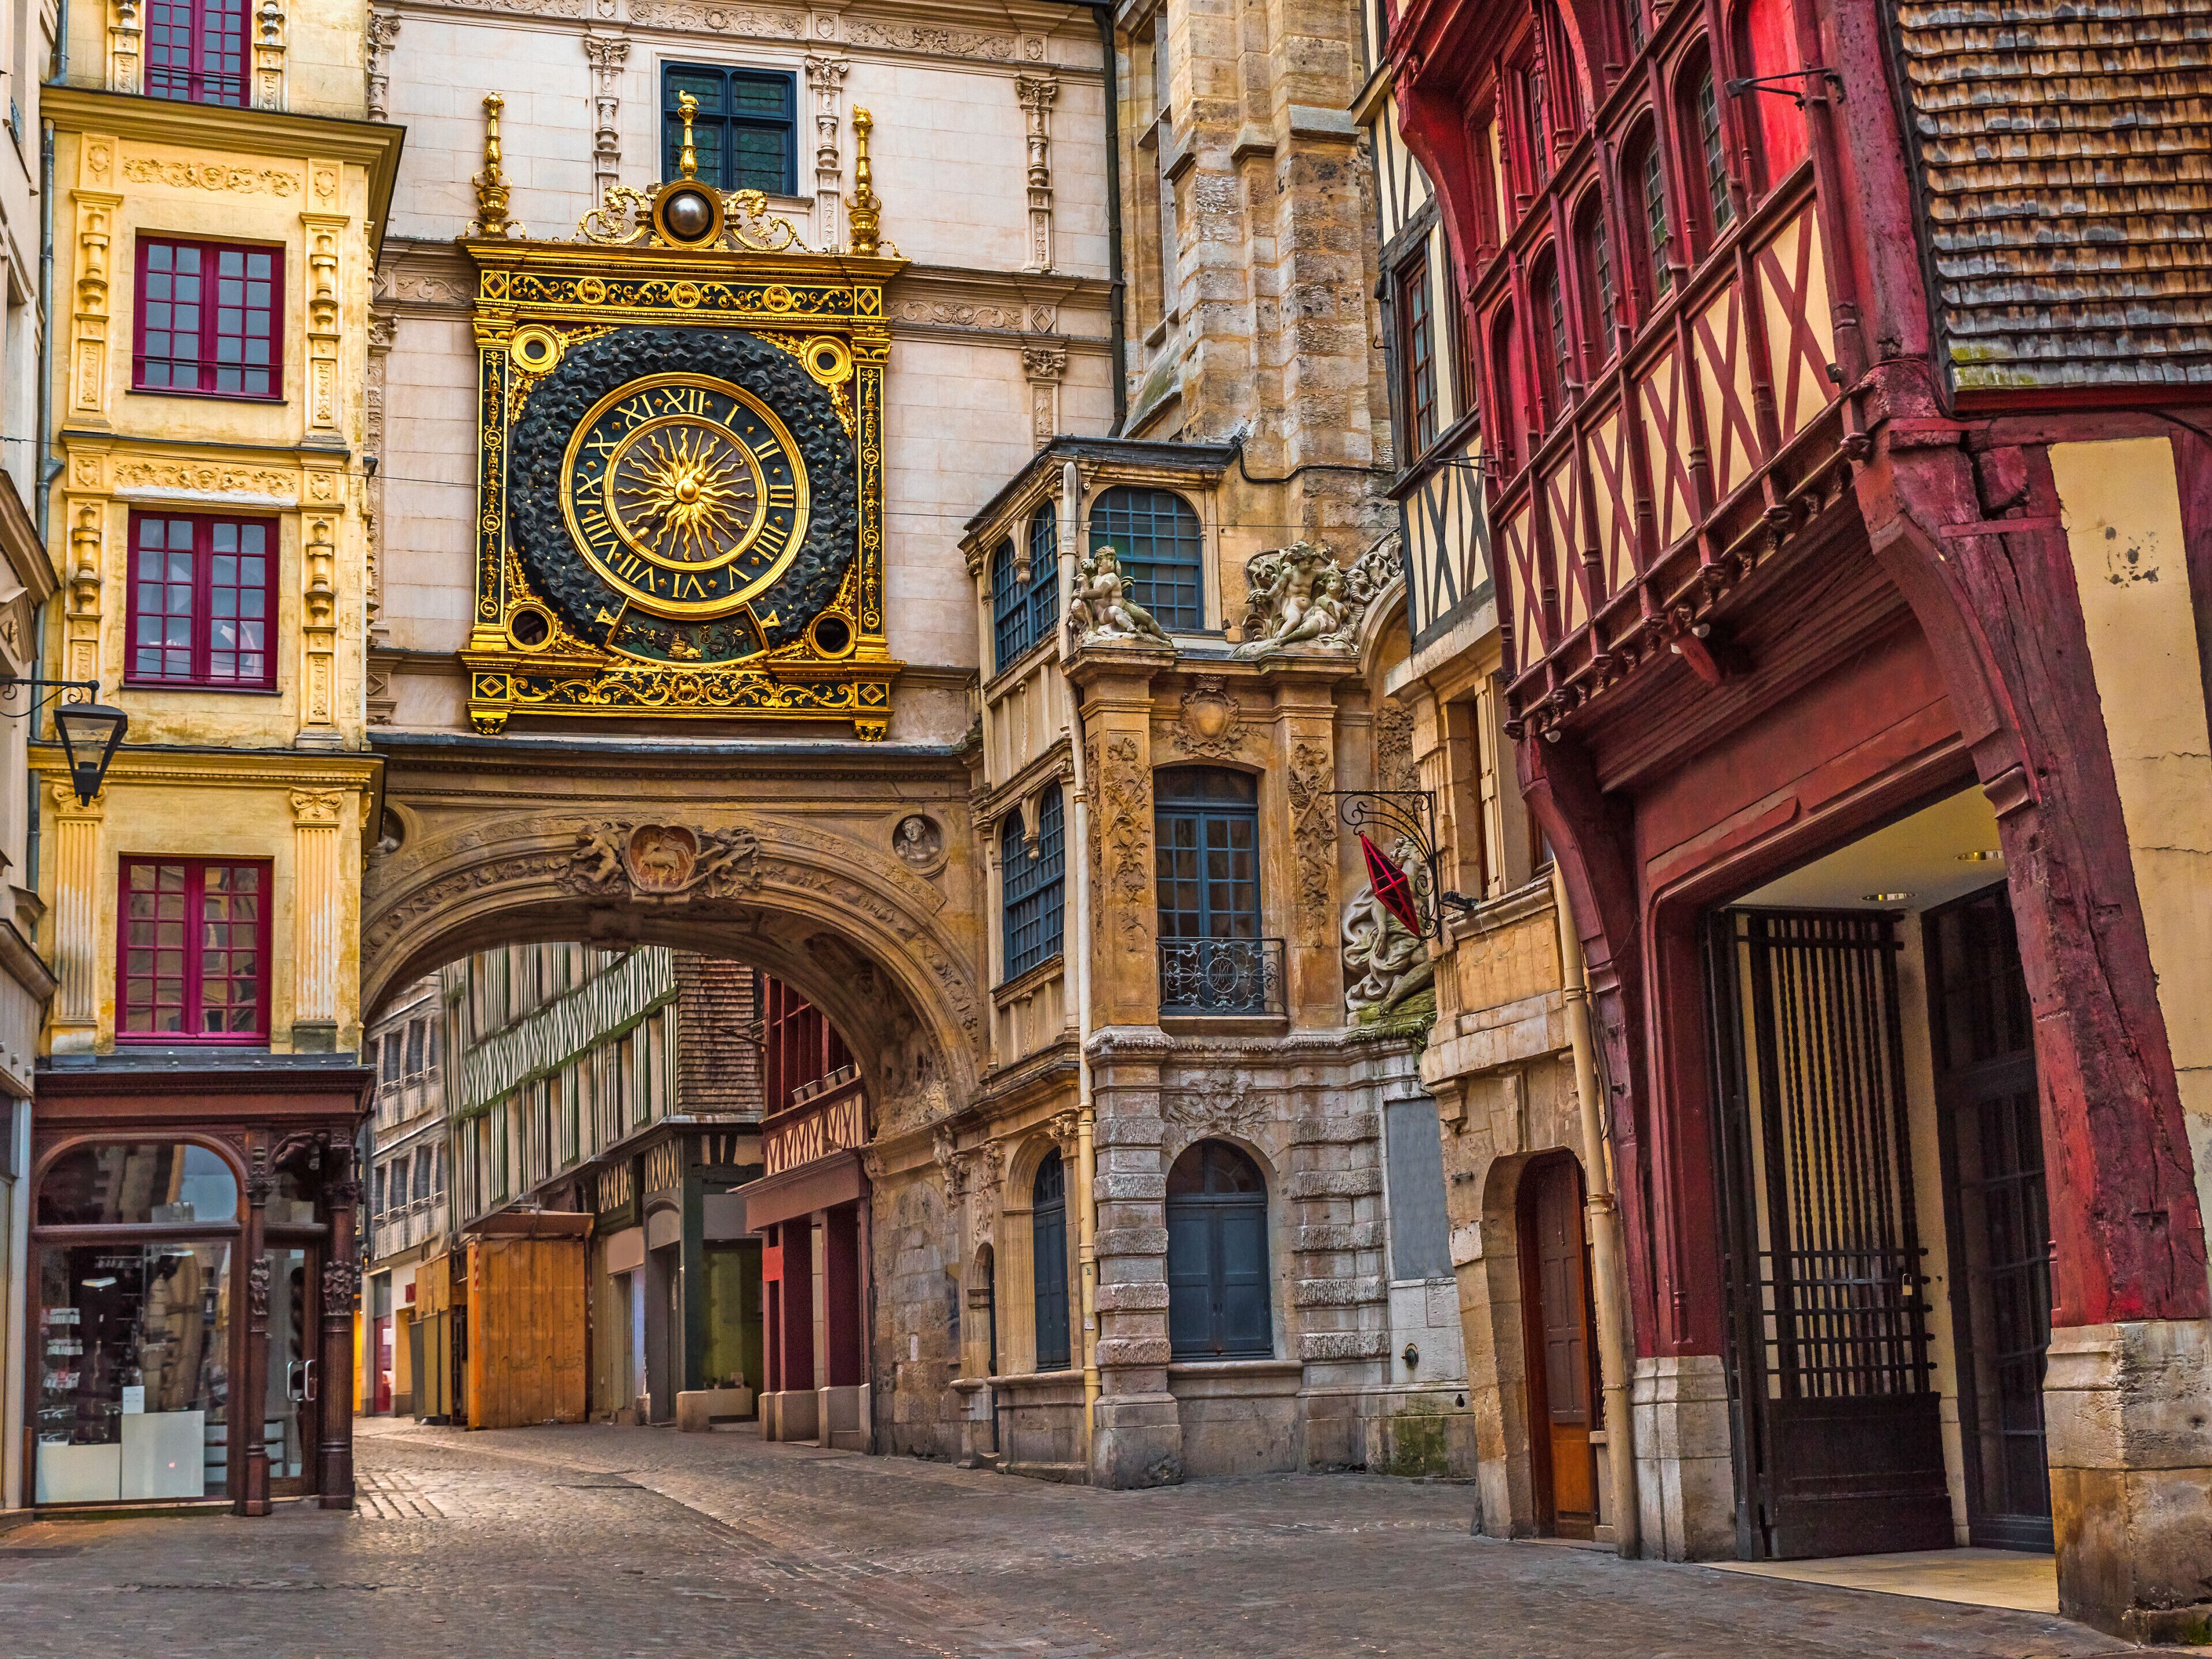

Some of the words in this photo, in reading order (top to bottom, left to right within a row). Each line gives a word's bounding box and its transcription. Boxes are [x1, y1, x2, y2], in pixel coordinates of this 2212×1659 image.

[615, 394, 656, 430] XI
[661, 388, 706, 415] XII
[724, 404, 740, 427] I
[585, 427, 619, 459] X
[753, 437, 781, 461] II
[577, 472, 603, 506] IX
[770, 484, 794, 508] III
[580, 511, 620, 565] VIII
[751, 523, 787, 562] IIII
[615, 552, 656, 593] VII
[672, 574, 707, 598] VI
[728, 565, 752, 590] V
